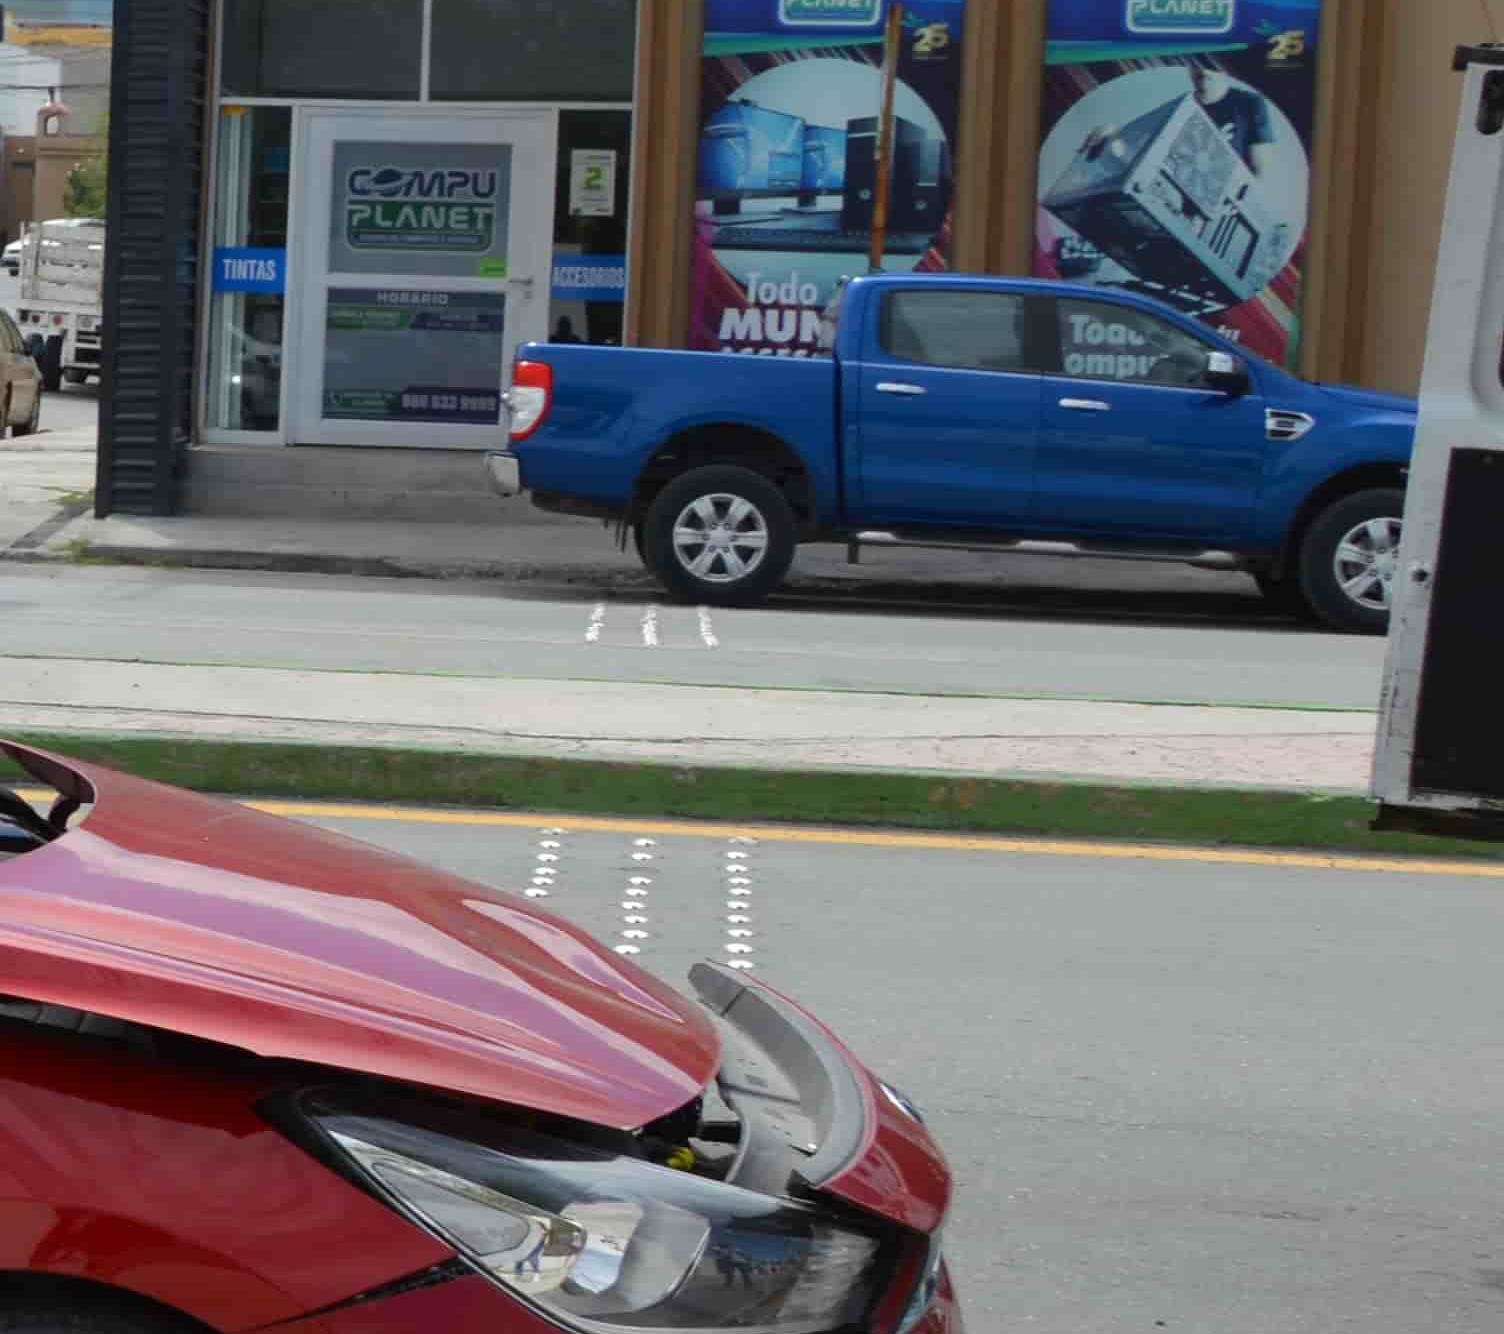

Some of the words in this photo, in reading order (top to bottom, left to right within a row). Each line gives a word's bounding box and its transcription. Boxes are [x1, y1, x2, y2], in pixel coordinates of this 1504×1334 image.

[912, 22, 949, 53] 25
[1265, 30, 1305, 60] 25
[348, 168, 497, 199] COMPU
[347, 202, 495, 232] PLANET
[222, 258, 276, 281] TINTAS
[376, 290, 449, 306] HORARIO
[746, 270, 817, 306] Todo
